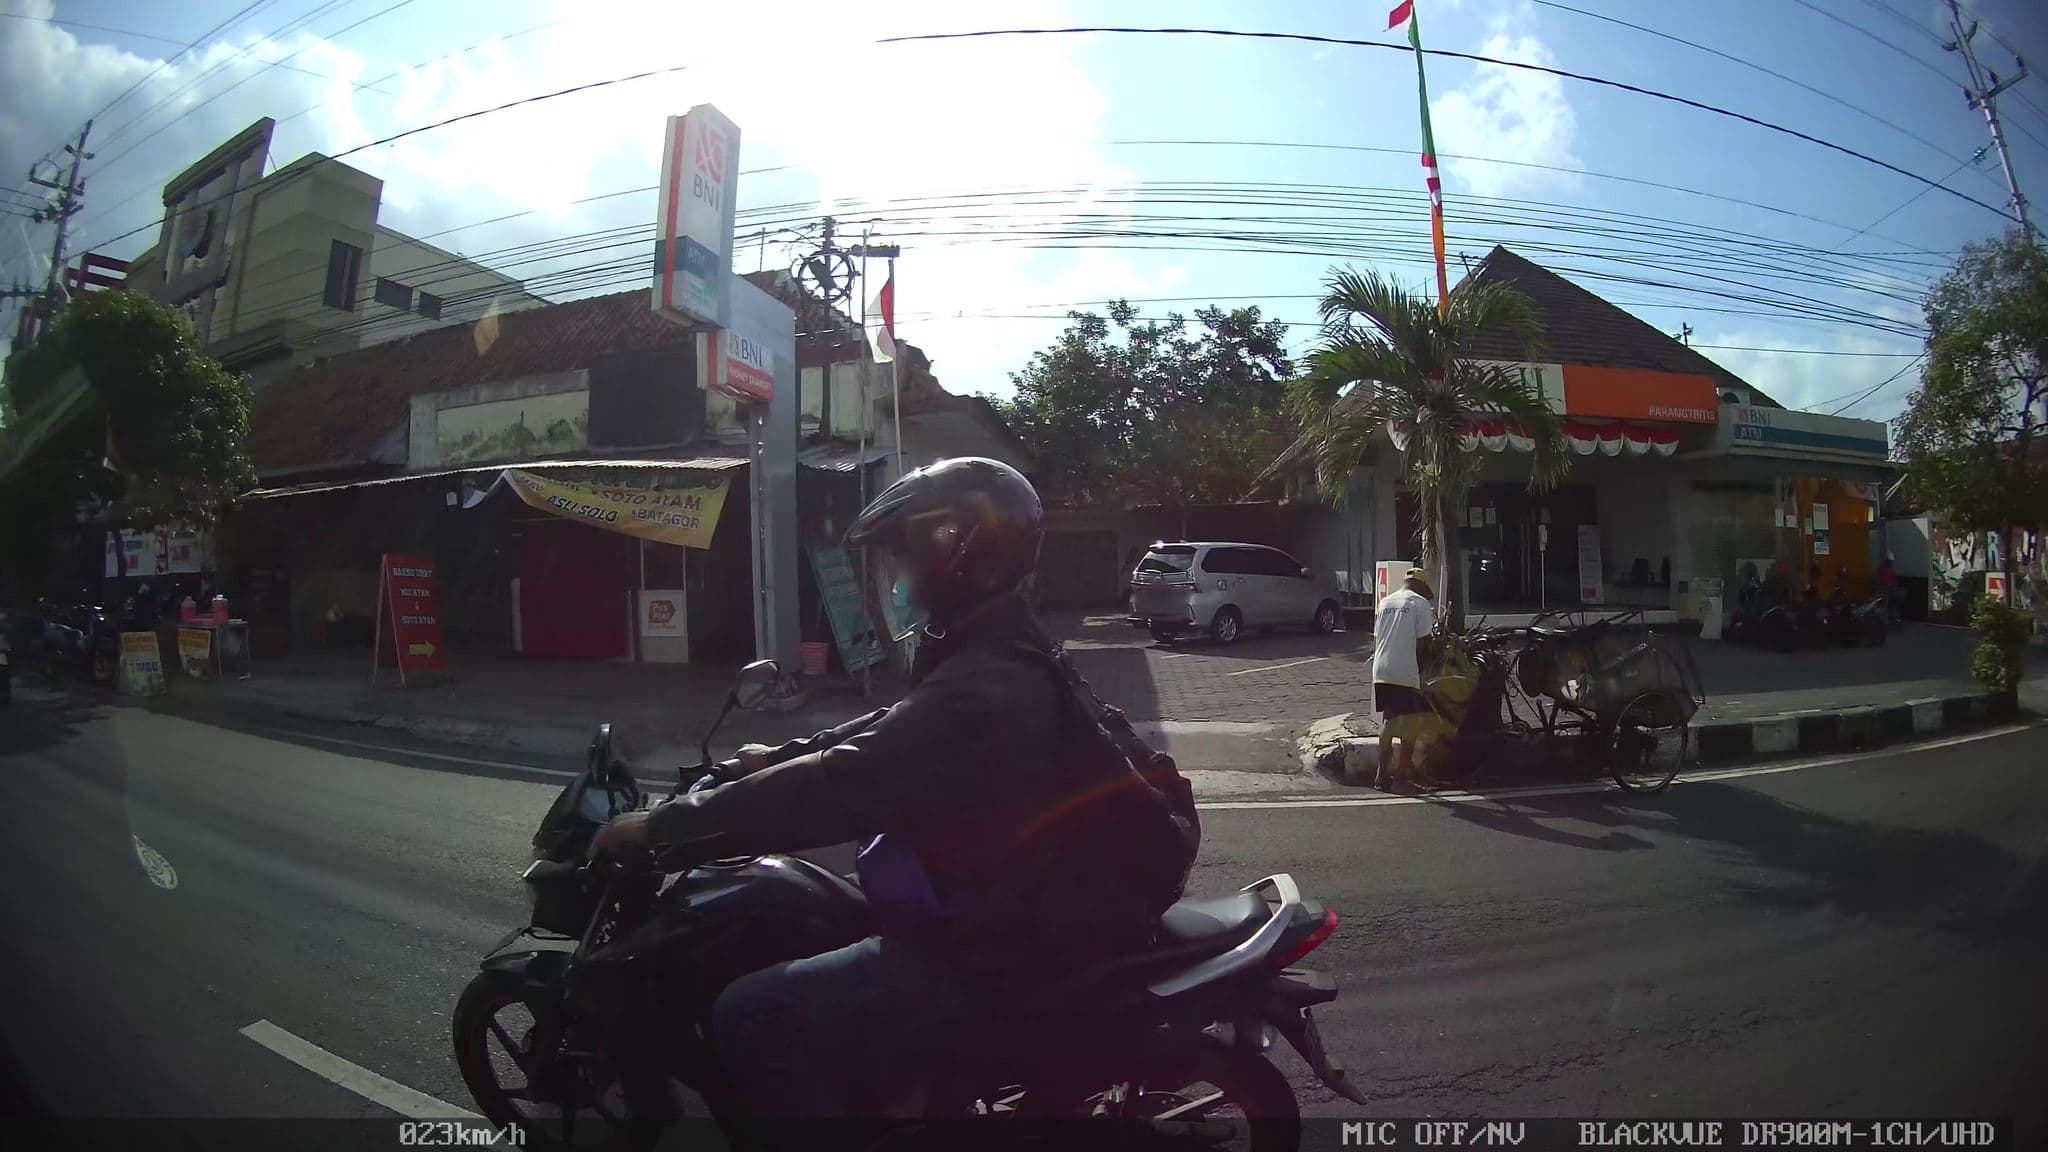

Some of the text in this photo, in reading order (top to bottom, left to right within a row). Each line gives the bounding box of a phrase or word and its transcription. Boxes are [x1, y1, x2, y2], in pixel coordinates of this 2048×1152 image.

[693, 173, 720, 212] BNI
[741, 337, 763, 367] BNI
[1648, 405, 1716, 422] PARANGTRITIS
[1749, 408, 1771, 426] BNI
[1740, 428, 1762, 441] ATM
[600, 489, 647, 505] SOTO
[547, 495, 619, 523] ASLI SOLO
[638, 508, 702, 529] BATAGOR
